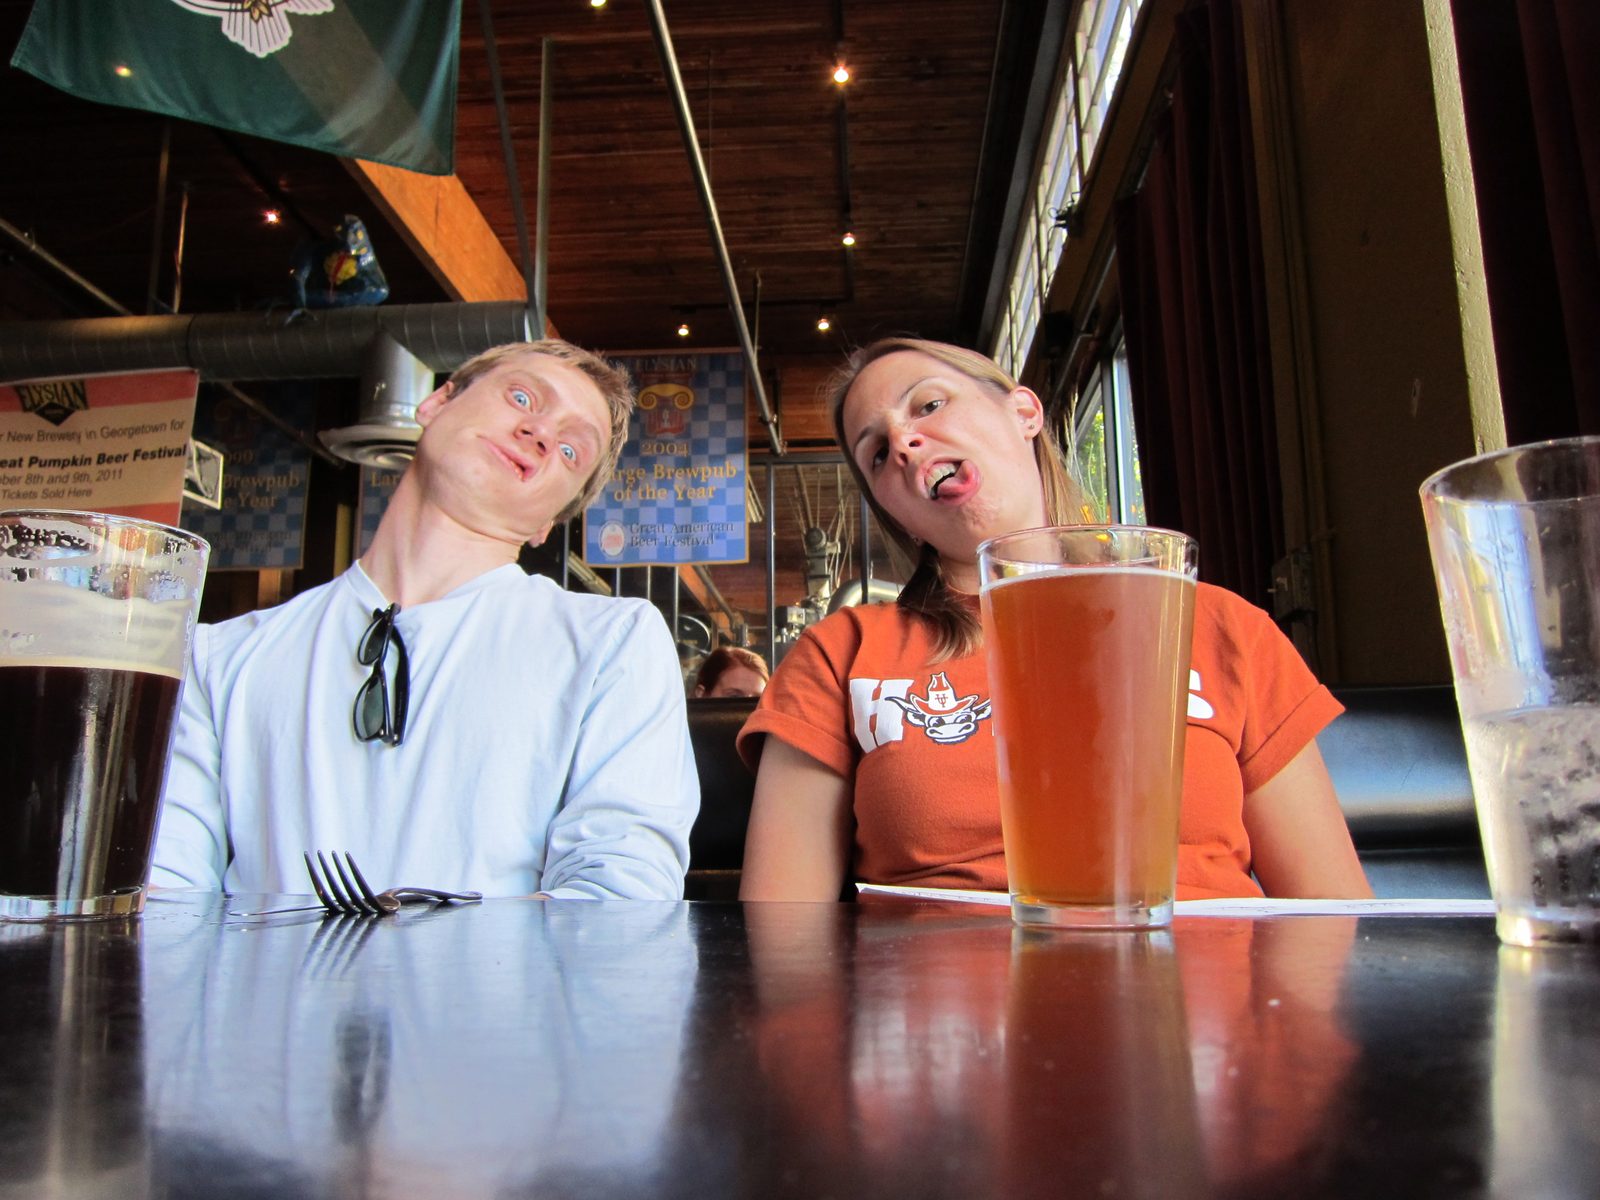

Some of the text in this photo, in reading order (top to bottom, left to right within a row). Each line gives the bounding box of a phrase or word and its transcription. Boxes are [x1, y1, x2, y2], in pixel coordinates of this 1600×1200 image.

[13, 379, 90, 413] ELYSIAN
[7, 430, 33, 442] New
[37, 428, 82, 445] Brewery
[85, 428, 97, 440] in
[100, 423, 167, 440] Georgetown
[170, 418, 186, 431] for
[0, 444, 187, 470] eat Pumpkin Beer Festival
[25, 472, 44, 485] 8th
[46, 472, 70, 484] and
[95, 468, 123, 482] 2011
[653, 461, 737, 482] Brewpub
[2, 486, 93, 499] Tickets Sold Here
[614, 482, 716, 501] of the Year
[629, 519, 735, 535] Great American
[630, 535, 658, 547] Beer
[664, 532, 714, 547] Festival
